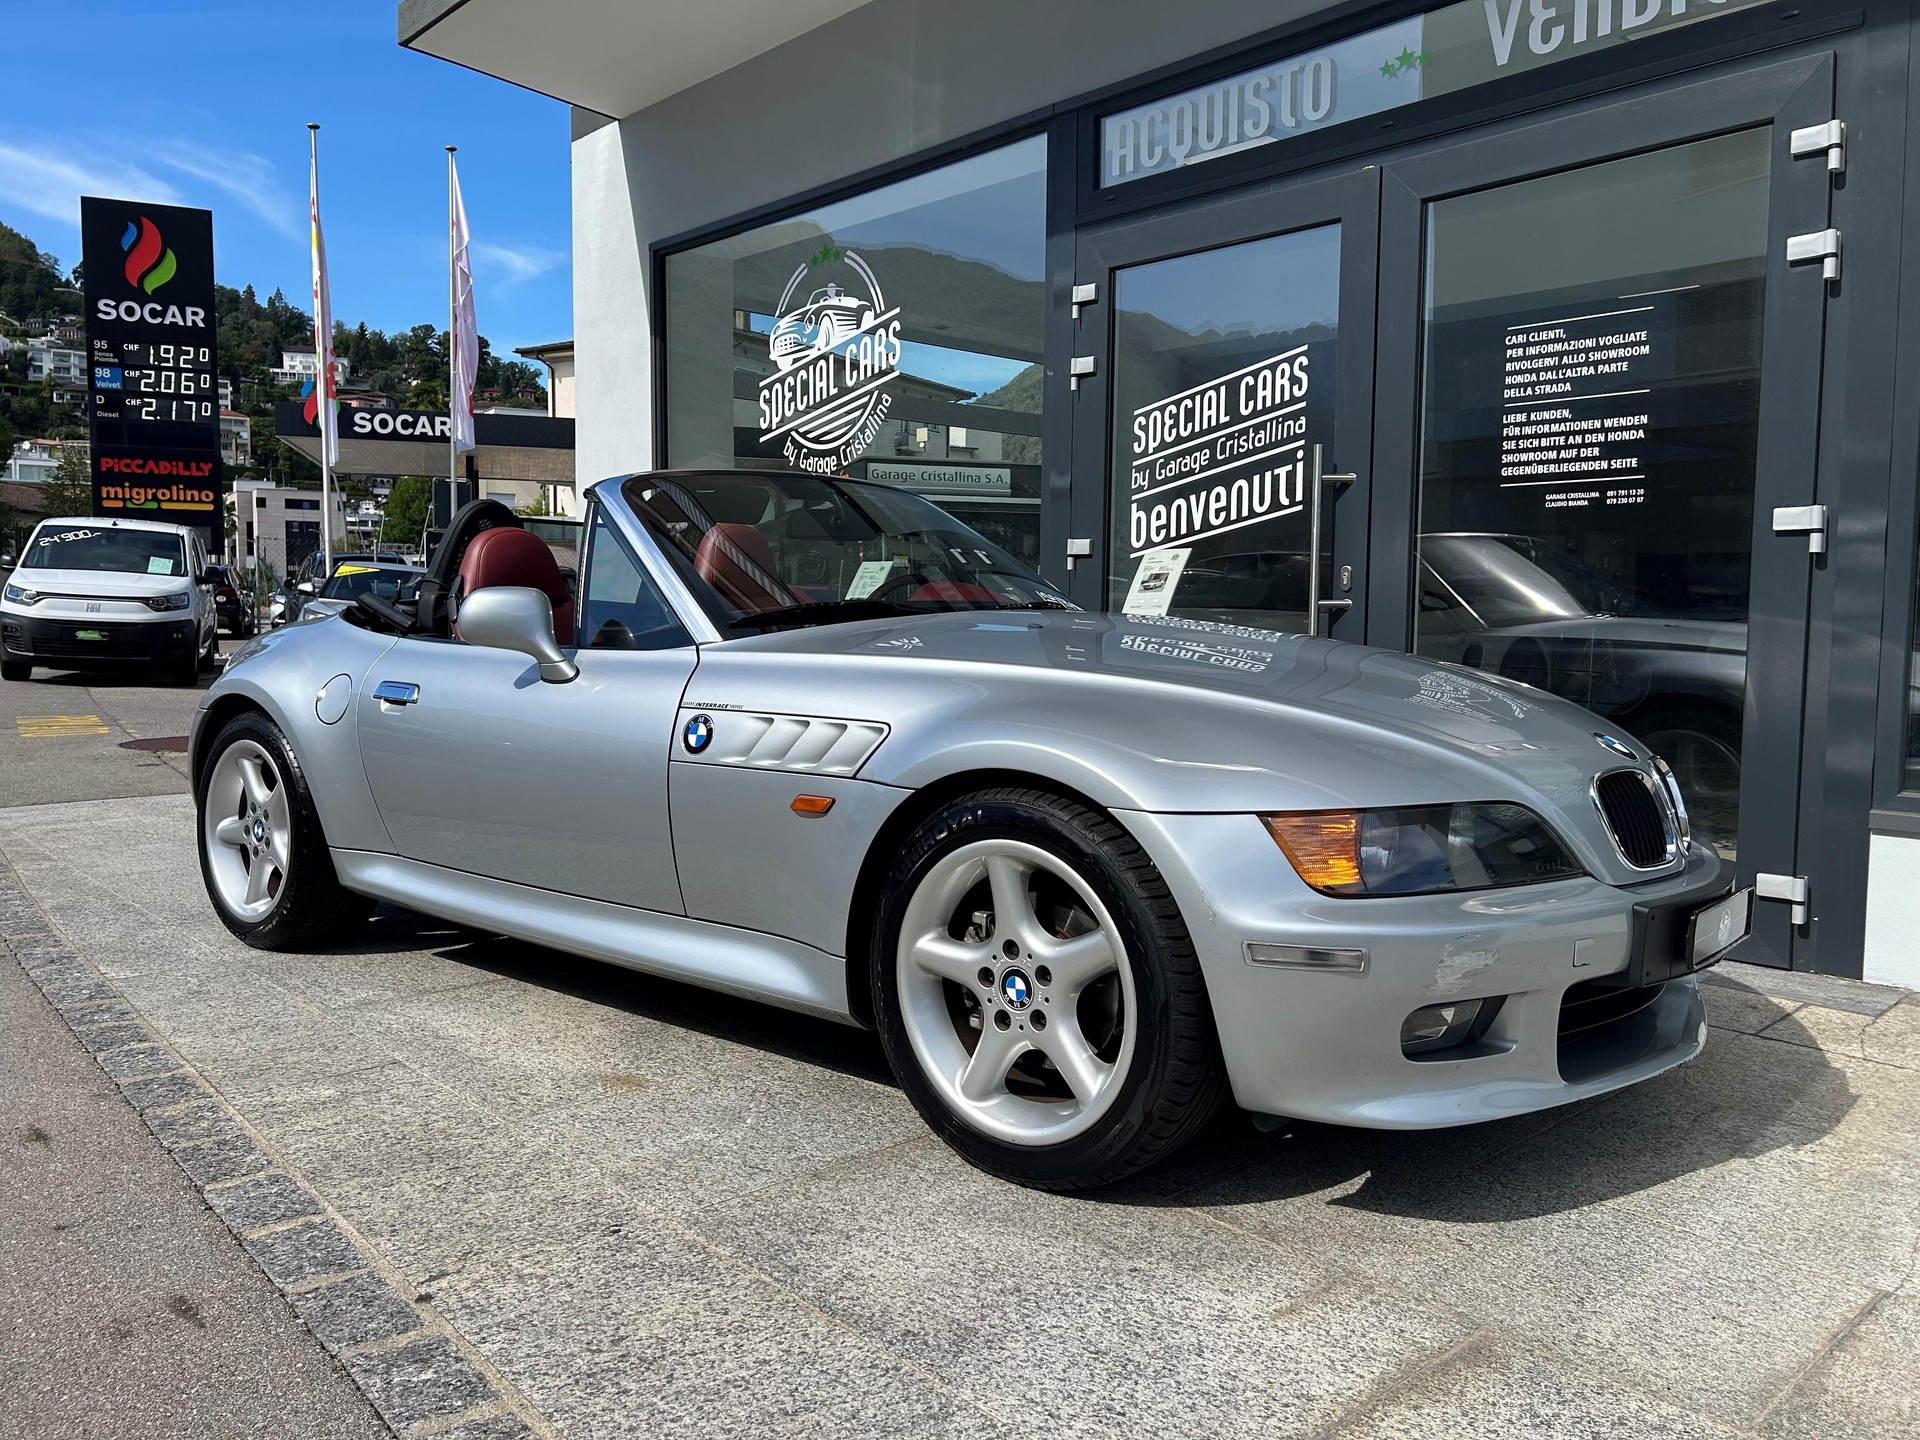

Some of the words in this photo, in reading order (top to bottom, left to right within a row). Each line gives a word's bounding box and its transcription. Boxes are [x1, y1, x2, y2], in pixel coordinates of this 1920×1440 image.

[1105, 55, 1333, 177] ACQUISTO
[97, 299, 205, 327] SOCAR
[93, 340, 108, 349] 95
[1505, 333, 1527, 345] CARI
[1529, 329, 1567, 342] CLIENTI,
[1506, 348, 1524, 358] PER
[1525, 338, 1596, 356] INFORMAZIONI
[1598, 331, 1647, 346] VOGLIATE
[1505, 356, 1559, 371] RIVOLGERVI
[1561, 353, 1586, 365] ALLO
[1588, 345, 1650, 362] SHOWROOM
[95, 368, 111, 378] 98
[124, 370, 140, 378] CHF
[759, 354, 838, 430] SPECIAL
[845, 320, 901, 387] CARS
[1505, 371, 1537, 385] HONDA
[1597, 361, 1629, 374] PARTE
[96, 380, 121, 389] Velvet
[1503, 385, 1533, 398] DELLA
[1534, 382, 1572, 395] STRADA
[96, 395, 105, 404] D
[125, 398, 142, 406] CHF
[1133, 384, 1230, 454] SPECIAL
[1239, 355, 1309, 416] CARS
[97, 410, 119, 418] Diesel
[353, 412, 451, 437] SOCAR
[1502, 412, 1527, 424] LIEBE
[1530, 408, 1572, 421] KUNDEN,
[783, 436, 798, 466] by
[800, 448, 838, 475] Garage
[840, 393, 892, 466] Cristallina
[1503, 425, 1521, 437] FÜR
[1521, 419, 1601, 436] INFORMATIONEN
[1603, 414, 1648, 428] WENDEN
[1502, 440, 1517, 450] SIE
[1518, 438, 1539, 449] SICH
[1540, 435, 1566, 447] BITTE
[1567, 434, 1583, 445] AN
[1584, 432, 1605, 444] DEN
[1607, 429, 1645, 442] HONDA
[1131, 468, 1149, 490] by
[1156, 448, 1210, 480] Garage
[1216, 415, 1306, 460] Cristallina
[1501, 450, 1557, 464] SHOWROOM
[1559, 448, 1578, 459] AUF
[1580, 447, 1600, 457] DER
[871, 468, 916, 482] Garage
[921, 470, 981, 484] Cristallina
[985, 474, 1008, 484] S.A.
[1501, 459, 1608, 476] GEGENÜBERLIEGENDEN
[1610, 457, 1638, 469] SEITE
[101, 482, 214, 504] migrolino
[1130, 449, 1304, 549] benvenuti
[1567, 491, 1600, 499] CRISTALLINA
[1618, 489, 1628, 497] 791
[85, 602, 102, 613] FIAT
[896, 809, 989, 881] UNIROYAL
